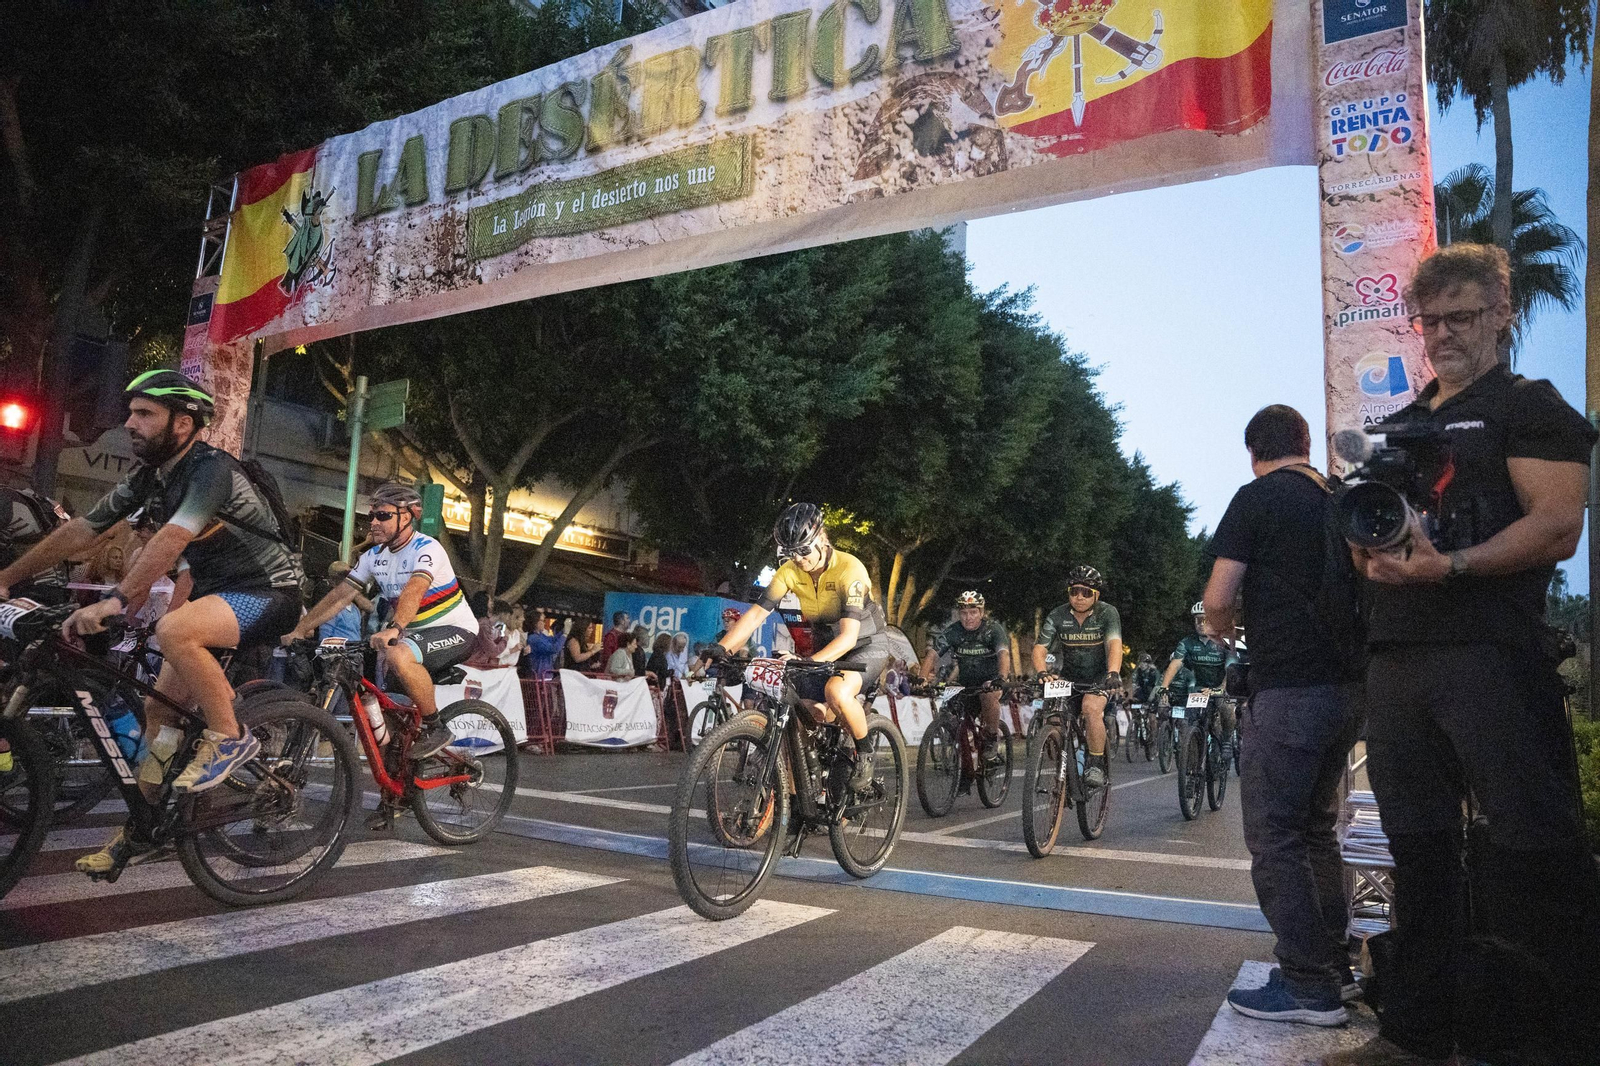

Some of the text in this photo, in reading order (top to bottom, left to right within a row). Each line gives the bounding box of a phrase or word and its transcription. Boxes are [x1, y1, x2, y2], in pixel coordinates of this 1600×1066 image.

[1340, 5, 1388, 23] SENATOR
[355, 0, 961, 224] LA DESÉRTICA
[1330, 93, 1407, 117] GRUPO
[1331, 106, 1411, 136] RENTA
[1331, 126, 1412, 156] TODO
[492, 165, 716, 236] La Legión y el desierto nos une
[426, 634, 466, 654] ASTANA
[752, 666, 782, 687] 5432
[1049, 681, 1072, 690] 5392
